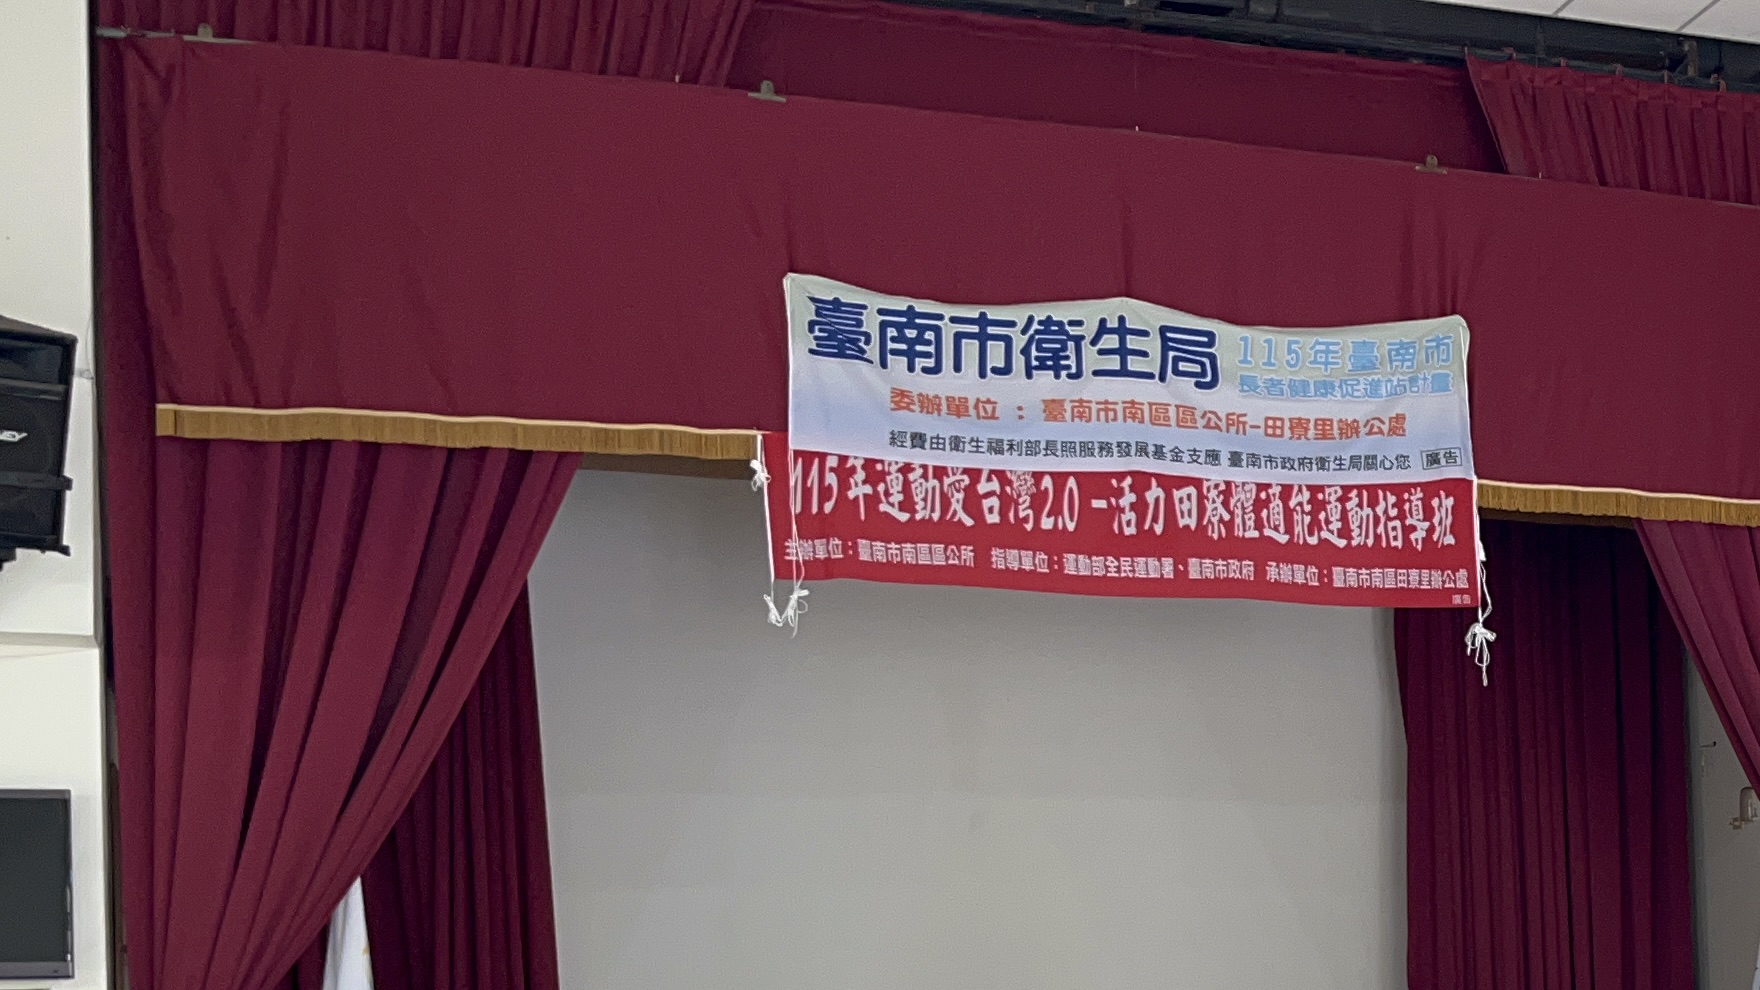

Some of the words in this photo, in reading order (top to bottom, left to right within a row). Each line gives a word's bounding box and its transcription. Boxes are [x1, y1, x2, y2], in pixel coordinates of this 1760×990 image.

[806, 295, 1220, 391] 臺南市衛生局
[1425, 450, 1460, 468] 廣告
